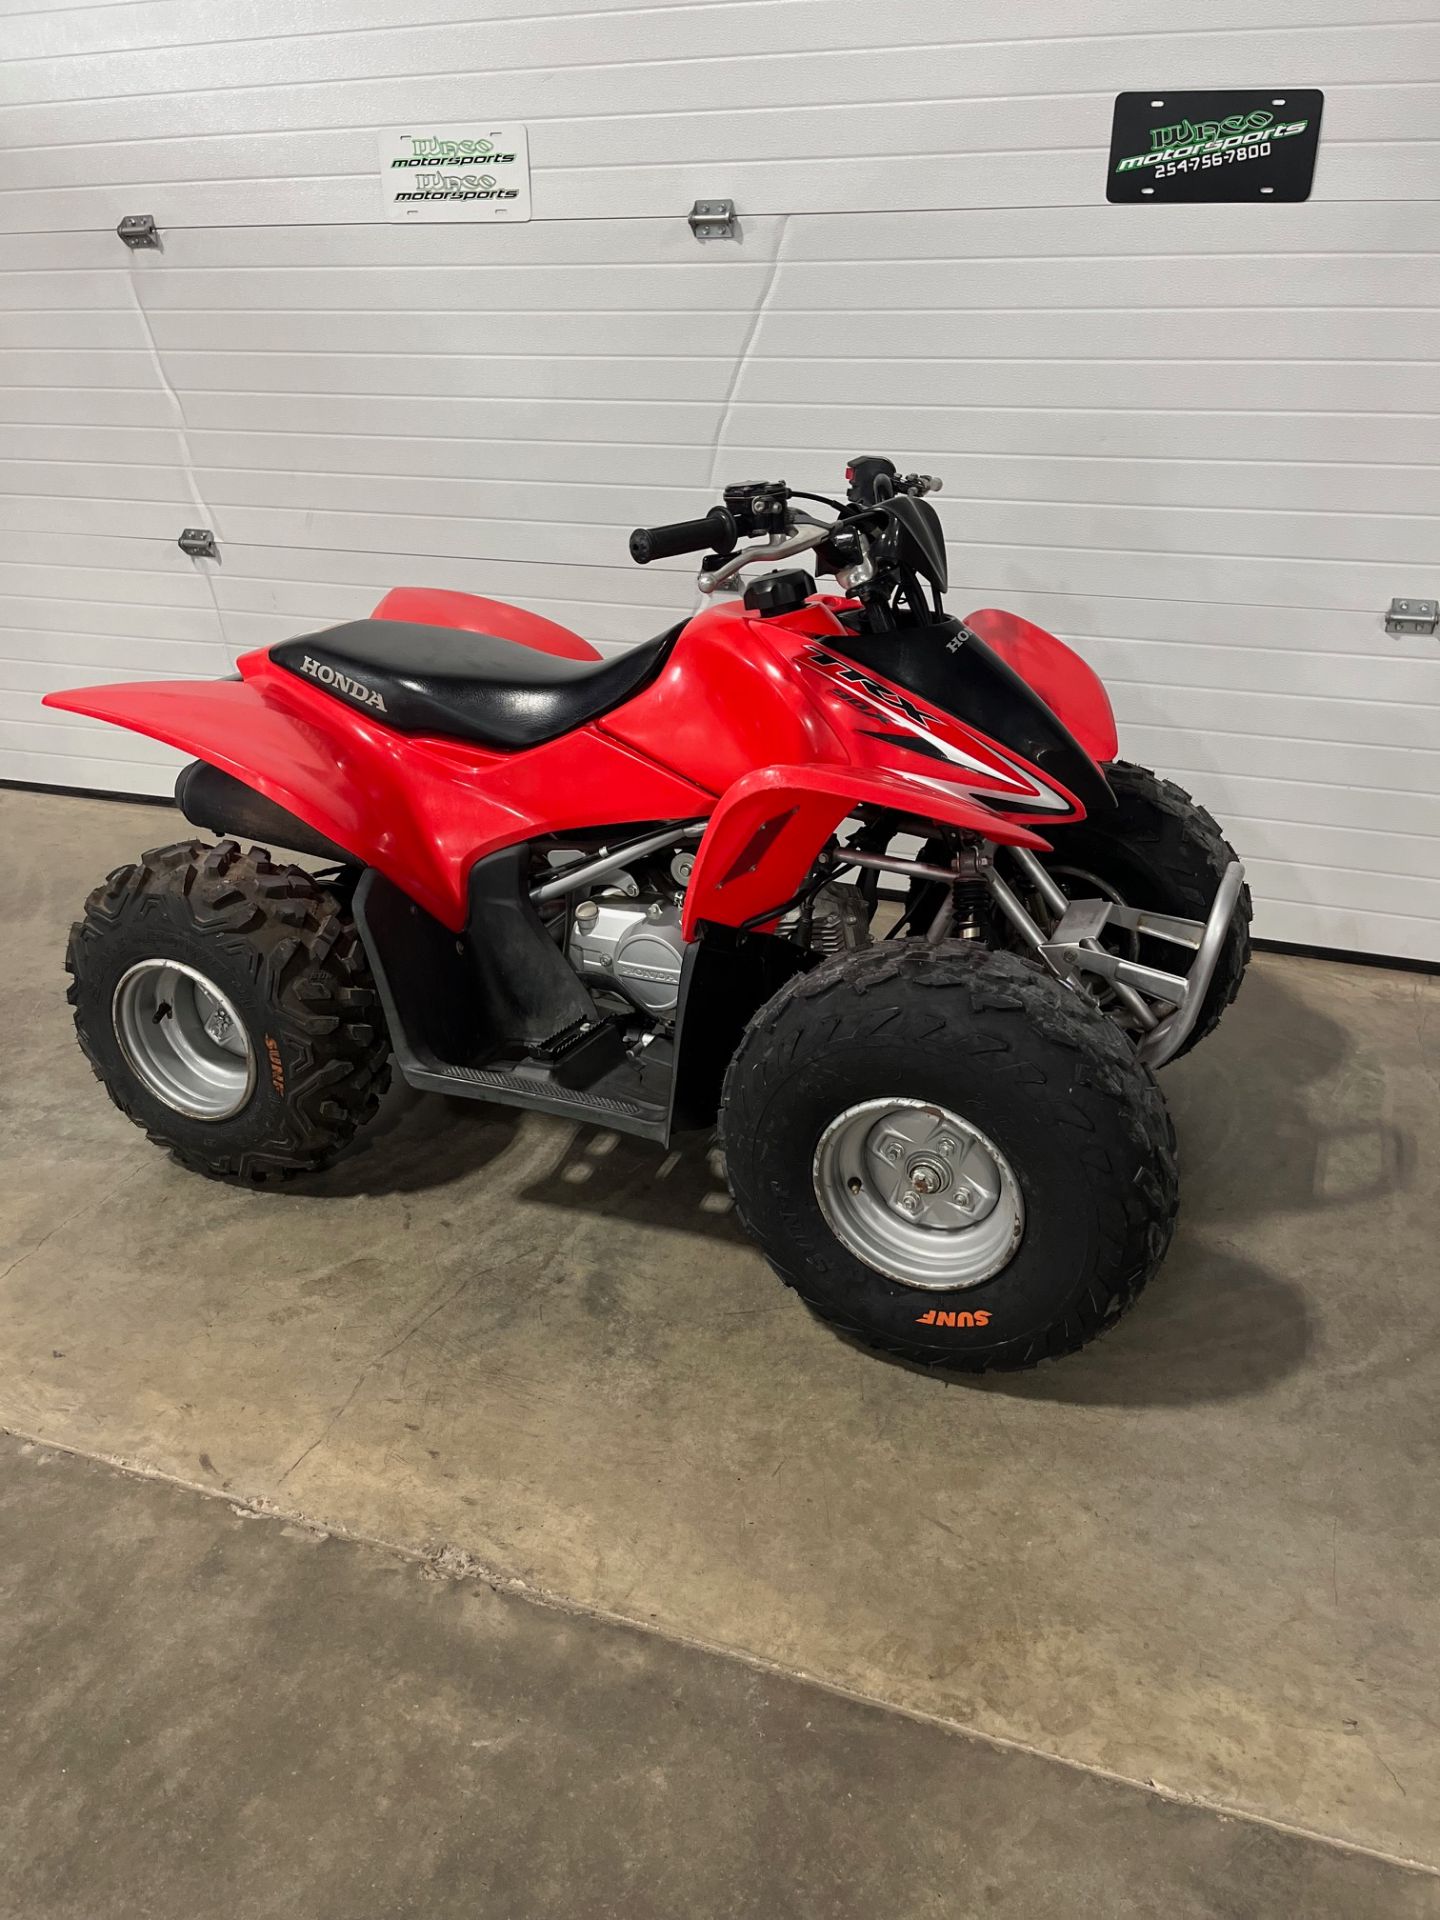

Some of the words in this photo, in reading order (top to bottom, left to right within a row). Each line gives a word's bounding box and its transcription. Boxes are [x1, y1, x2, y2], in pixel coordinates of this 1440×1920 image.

[391, 153, 517, 168] motorsports
[1116, 120, 1308, 172] motorsports
[1154, 142, 1271, 179] 254-756-7800
[394, 188, 519, 202] motorsports
[945, 628, 974, 654] HO
[300, 655, 388, 713] HONDA
[802, 644, 948, 730] TRX
[914, 1309, 993, 1328] SUNF
